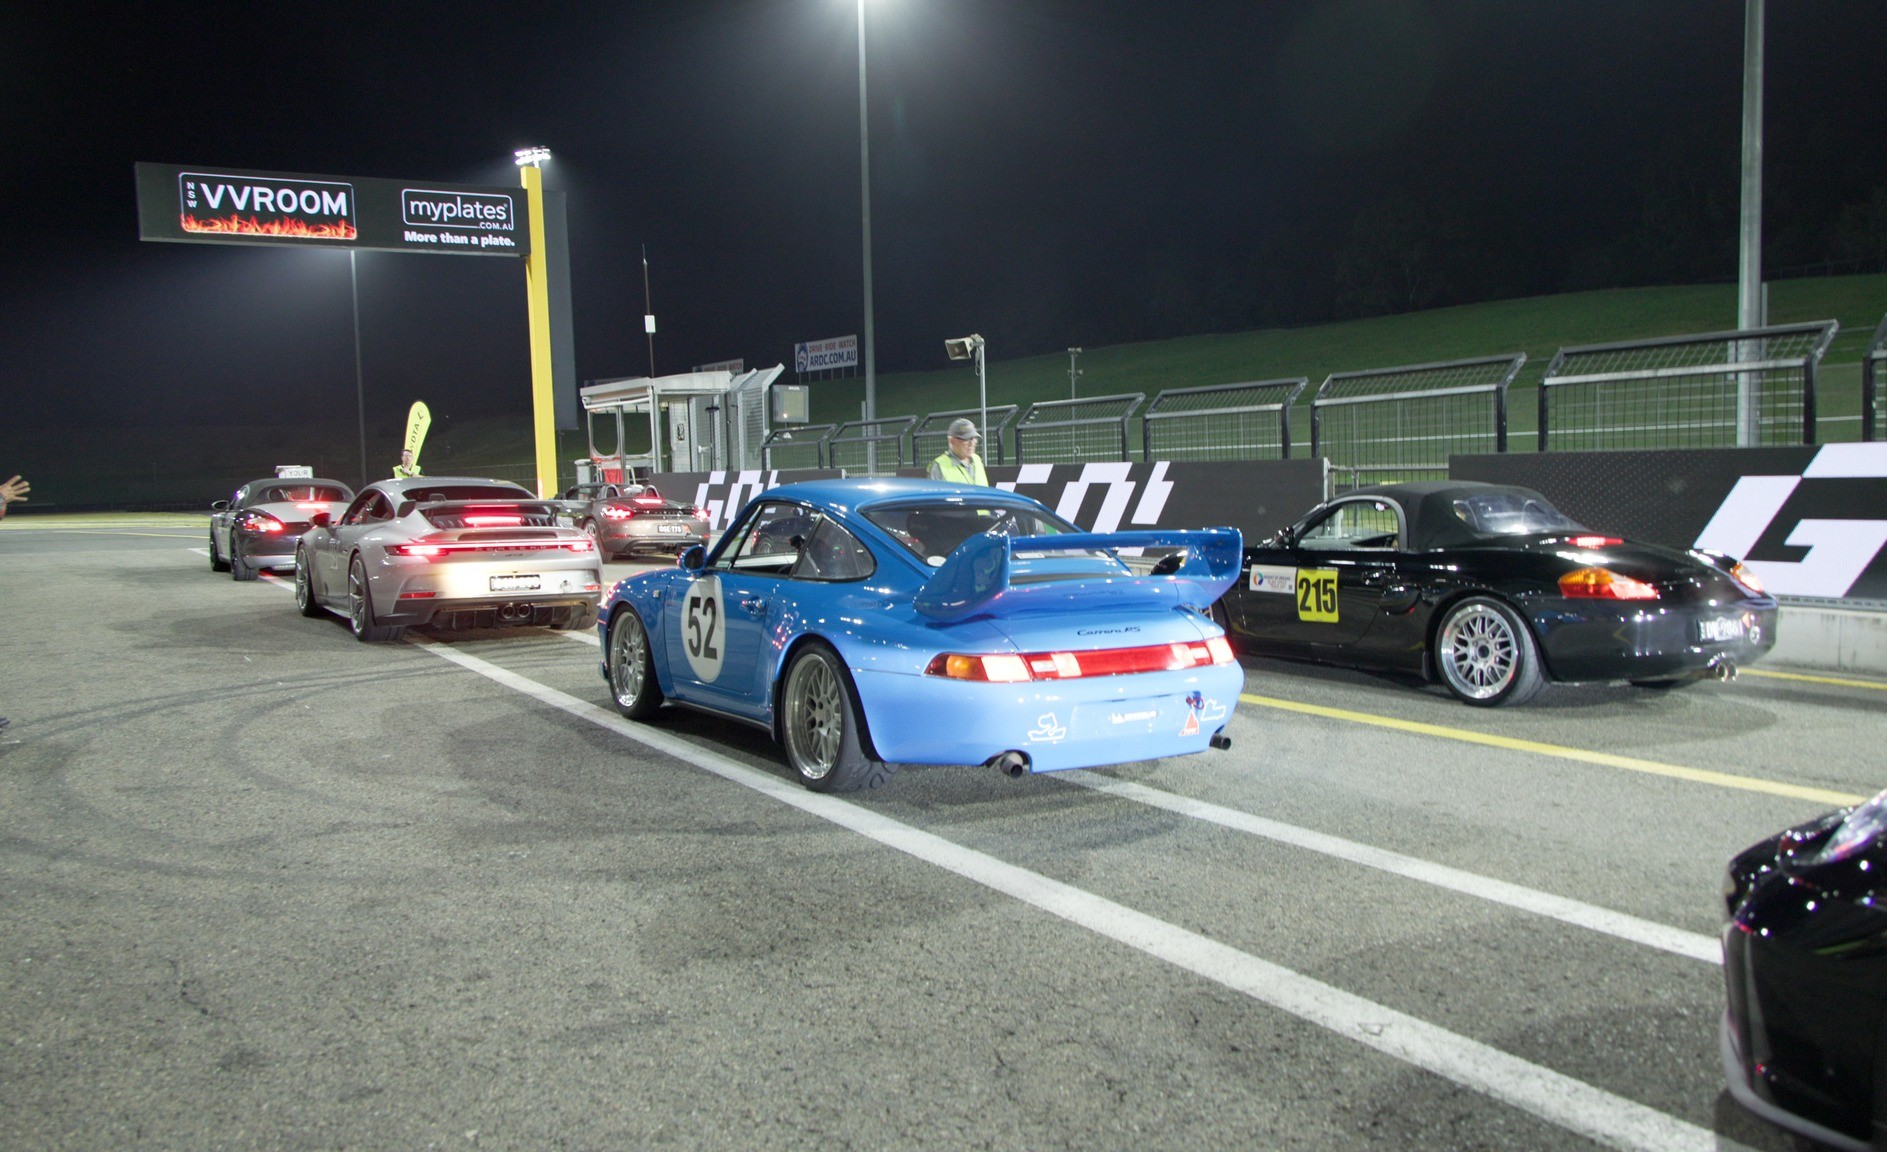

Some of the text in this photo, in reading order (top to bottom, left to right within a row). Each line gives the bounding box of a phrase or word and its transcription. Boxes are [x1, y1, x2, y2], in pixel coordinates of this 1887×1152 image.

[200, 183, 347, 216] VVROOM
[410, 196, 507, 222] myplates
[404, 231, 515, 248] More than a plate.
[825, 342, 836, 352] RIDE
[838, 339, 856, 350] WATCH
[809, 349, 856, 367] ARDC.COM.AU
[1298, 578, 1336, 613] 215
[688, 596, 717, 660] 52
[1077, 628, 1123, 637] Carrera
